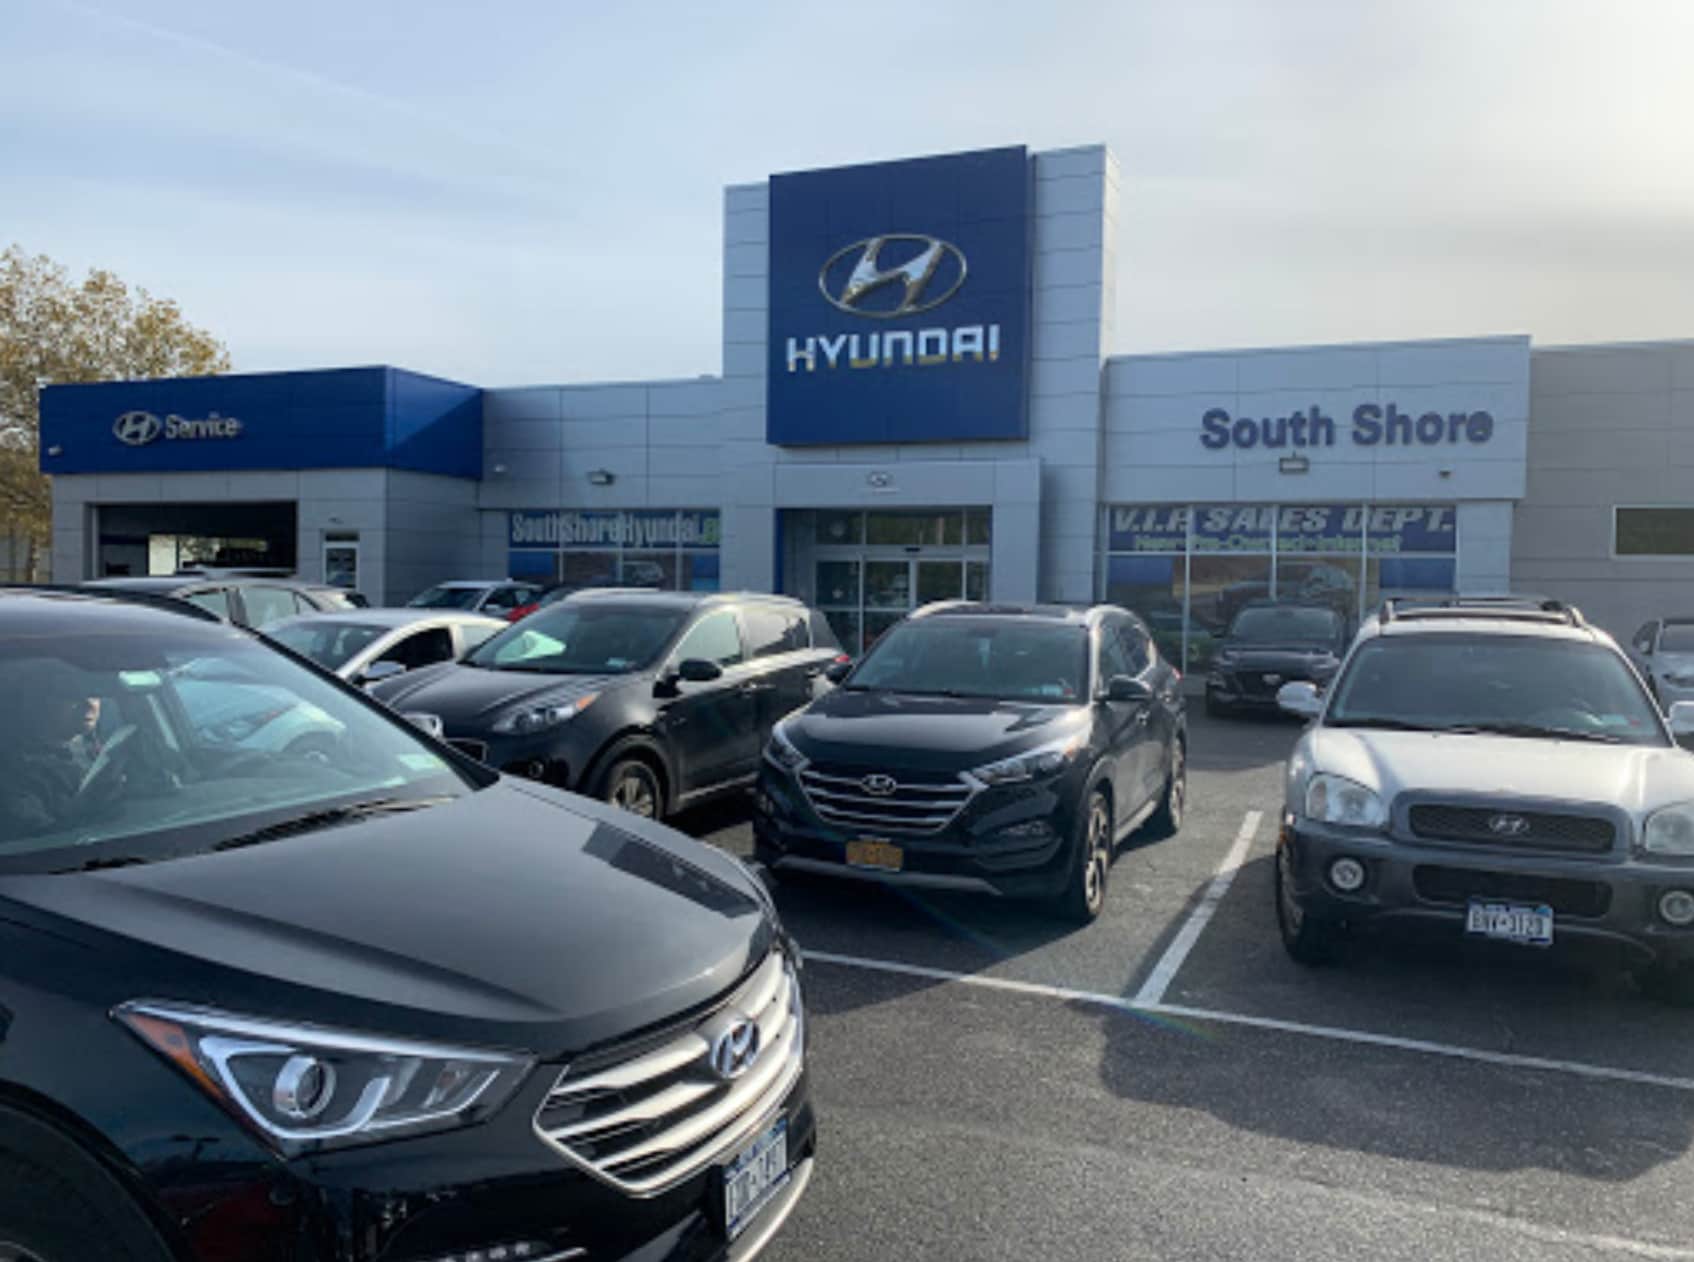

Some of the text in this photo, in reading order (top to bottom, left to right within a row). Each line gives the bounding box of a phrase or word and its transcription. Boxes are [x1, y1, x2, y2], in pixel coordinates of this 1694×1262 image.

[787, 324, 1000, 372] HYUNDAI
[165, 414, 240, 440] Service
[1200, 402, 1494, 449] South Shore
[1202, 507, 1331, 532] SALES
[1342, 507, 1453, 532] DEPT.
